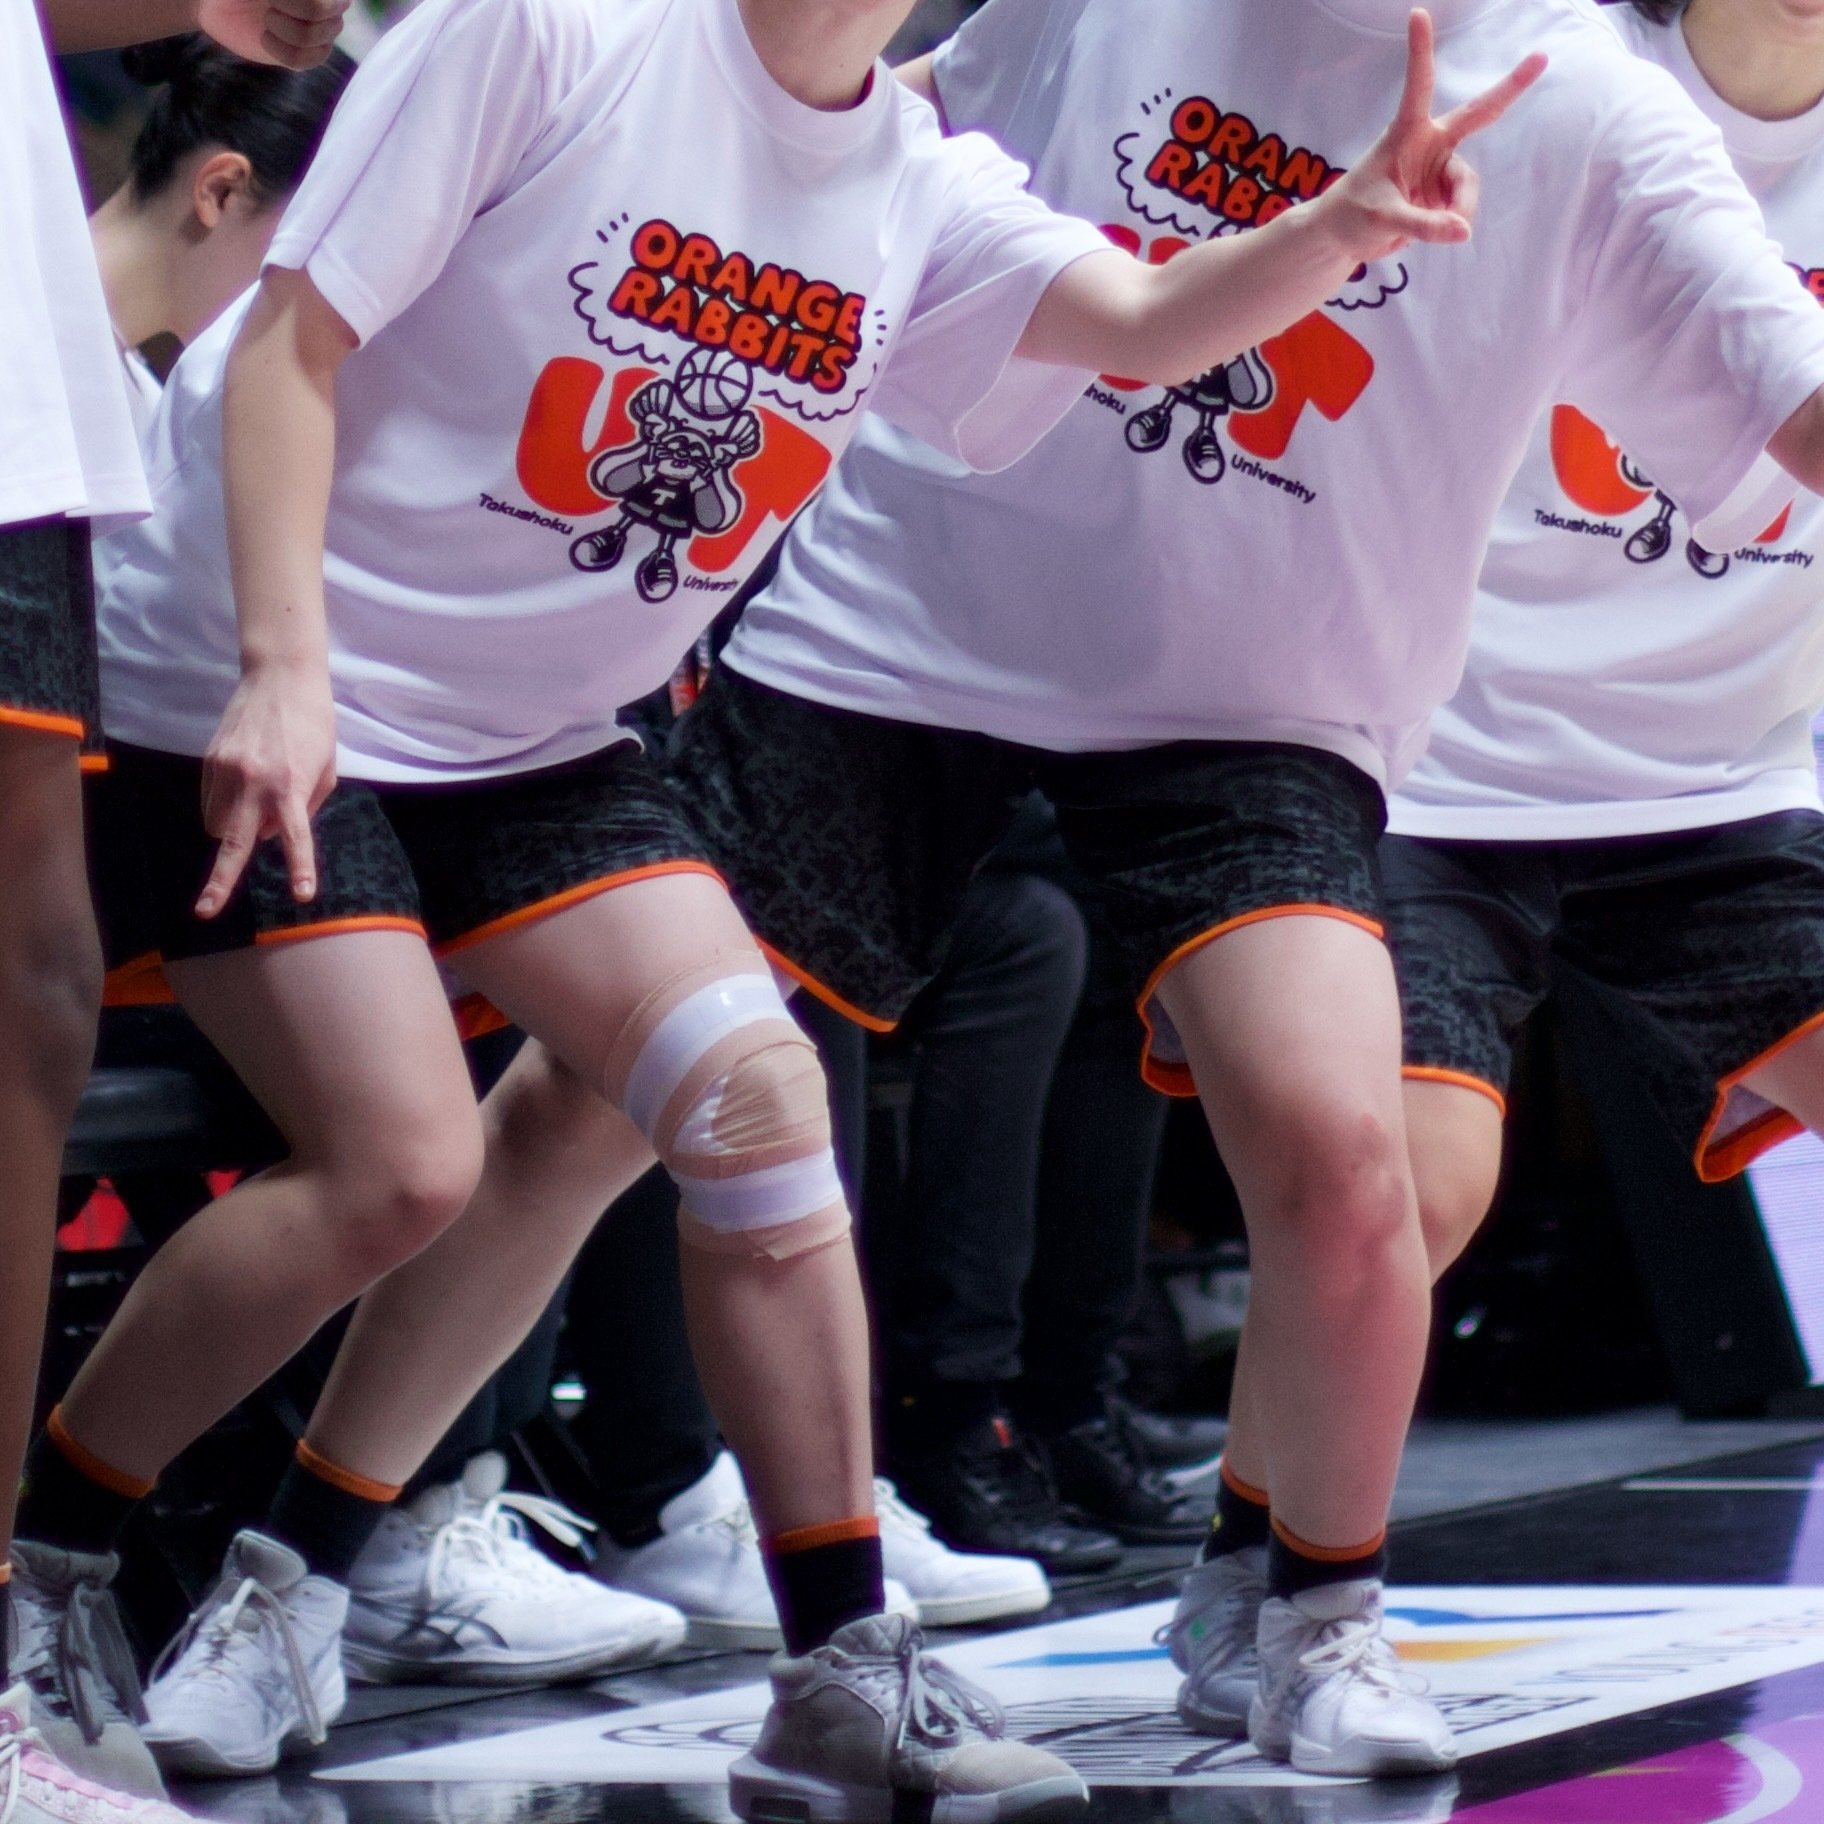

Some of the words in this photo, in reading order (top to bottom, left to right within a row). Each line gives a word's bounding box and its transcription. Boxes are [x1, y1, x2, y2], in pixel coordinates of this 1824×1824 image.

[1144, 139, 1296, 228] RABB
[1170, 95, 1348, 201] ORAN
[630, 219, 866, 345] ORANGE
[607, 265, 858, 394] RABBITS
[479, 492, 574, 535] Takushoku
[1230, 453, 1317, 504] University
[1534, 510, 1623, 539] Takushoku
